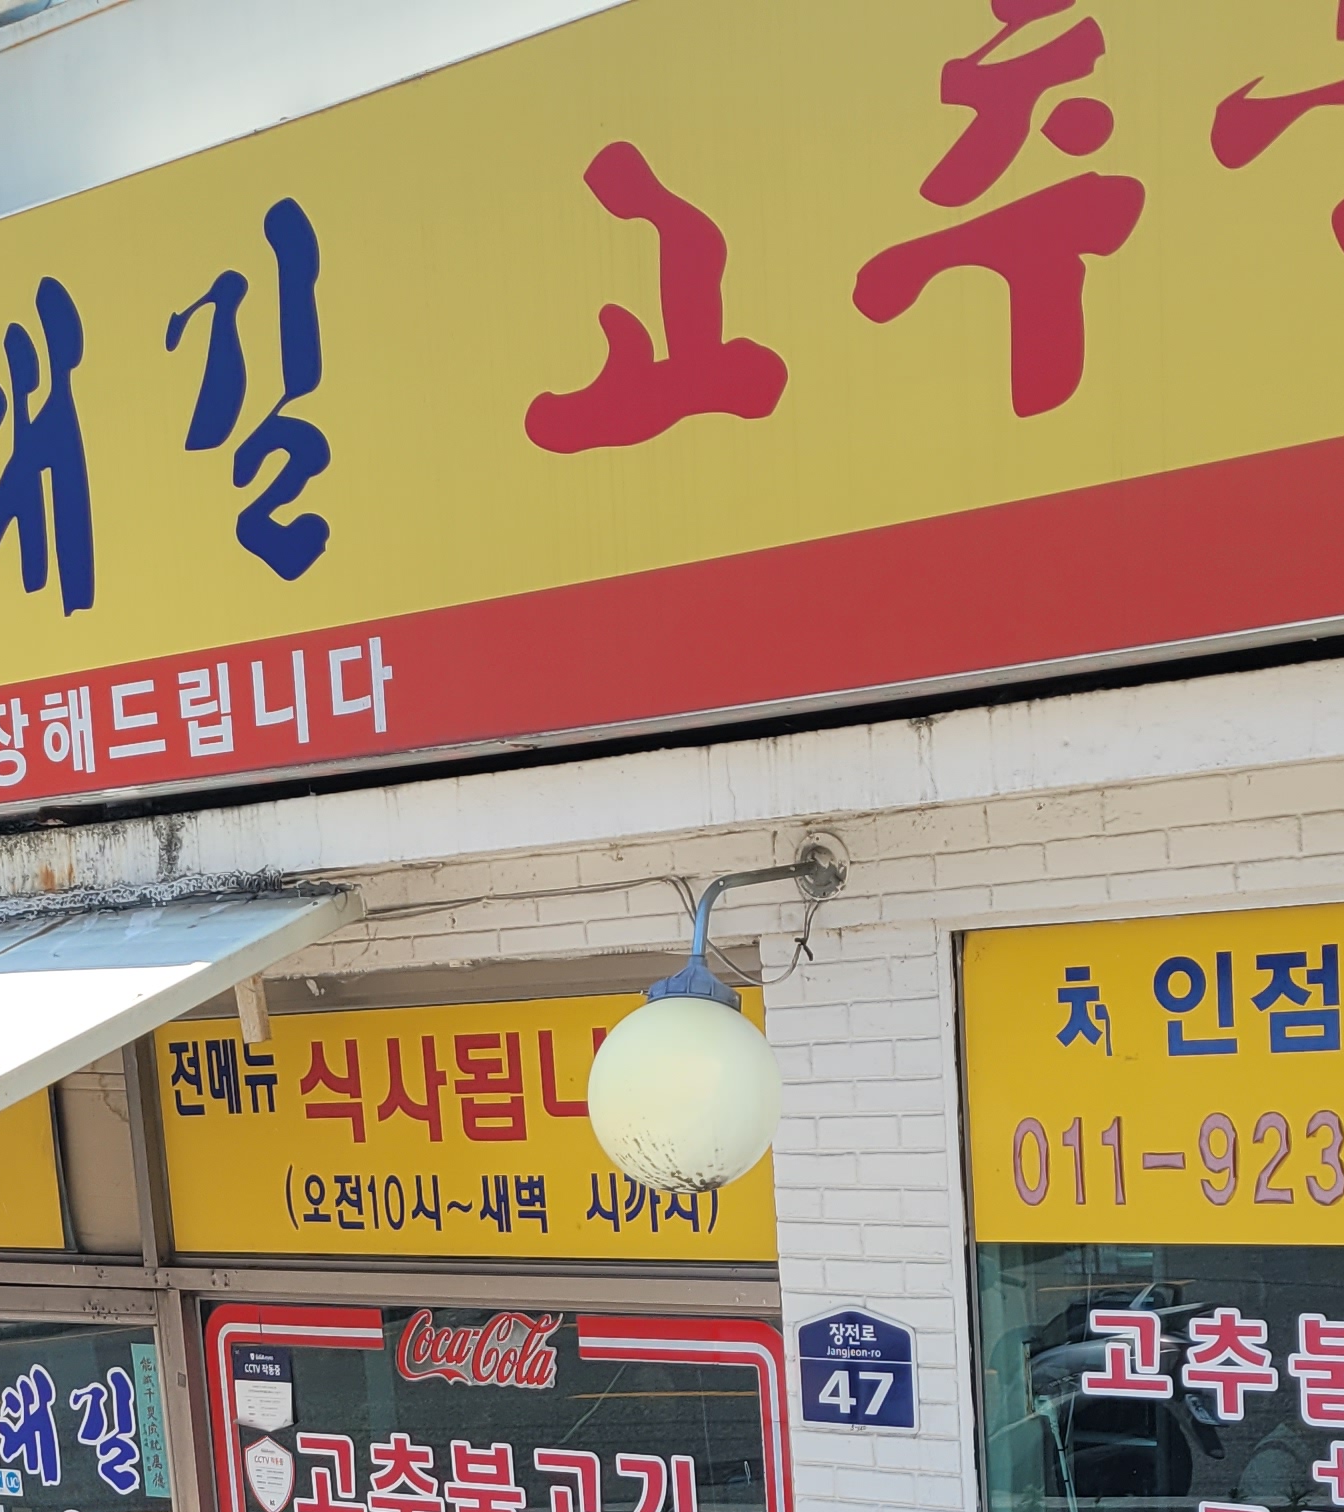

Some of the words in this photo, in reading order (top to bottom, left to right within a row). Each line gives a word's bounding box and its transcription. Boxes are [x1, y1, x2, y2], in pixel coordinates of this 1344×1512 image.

[169, 1039, 279, 1117] 전메뉴
[299, 1026, 609, 1144] 식사됩니
[396, 1308, 564, 1388] Coca-Cola
[826, 1346, 881, 1358] Jangjeon-ro
[829, 1323, 877, 1345] 장전로
[819, 1370, 894, 1416] 47
